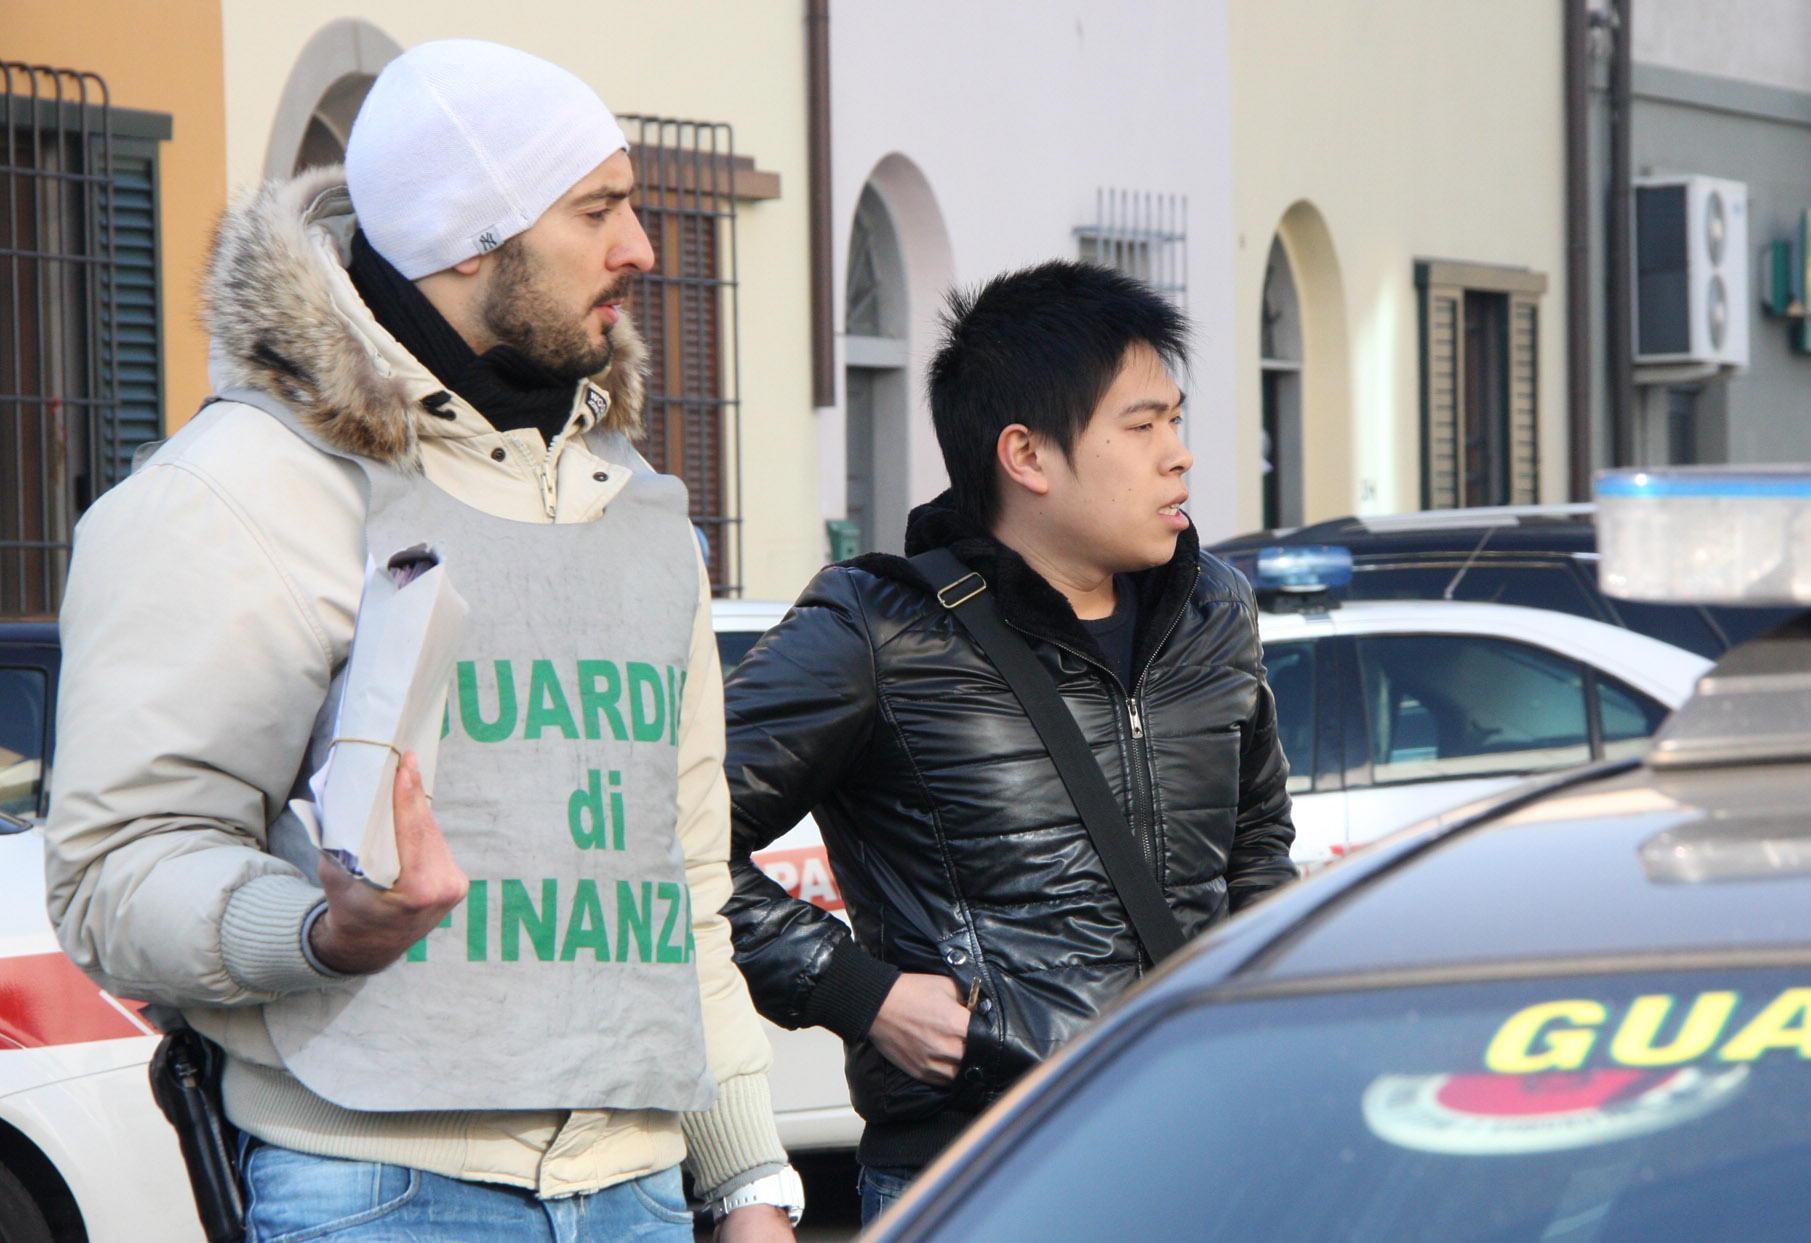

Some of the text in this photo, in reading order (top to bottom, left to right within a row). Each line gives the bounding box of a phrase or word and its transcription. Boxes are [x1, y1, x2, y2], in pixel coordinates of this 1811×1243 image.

[440, 659, 687, 747] UARDI
[568, 769, 626, 850] di
[1485, 987, 1811, 1074] GUA
